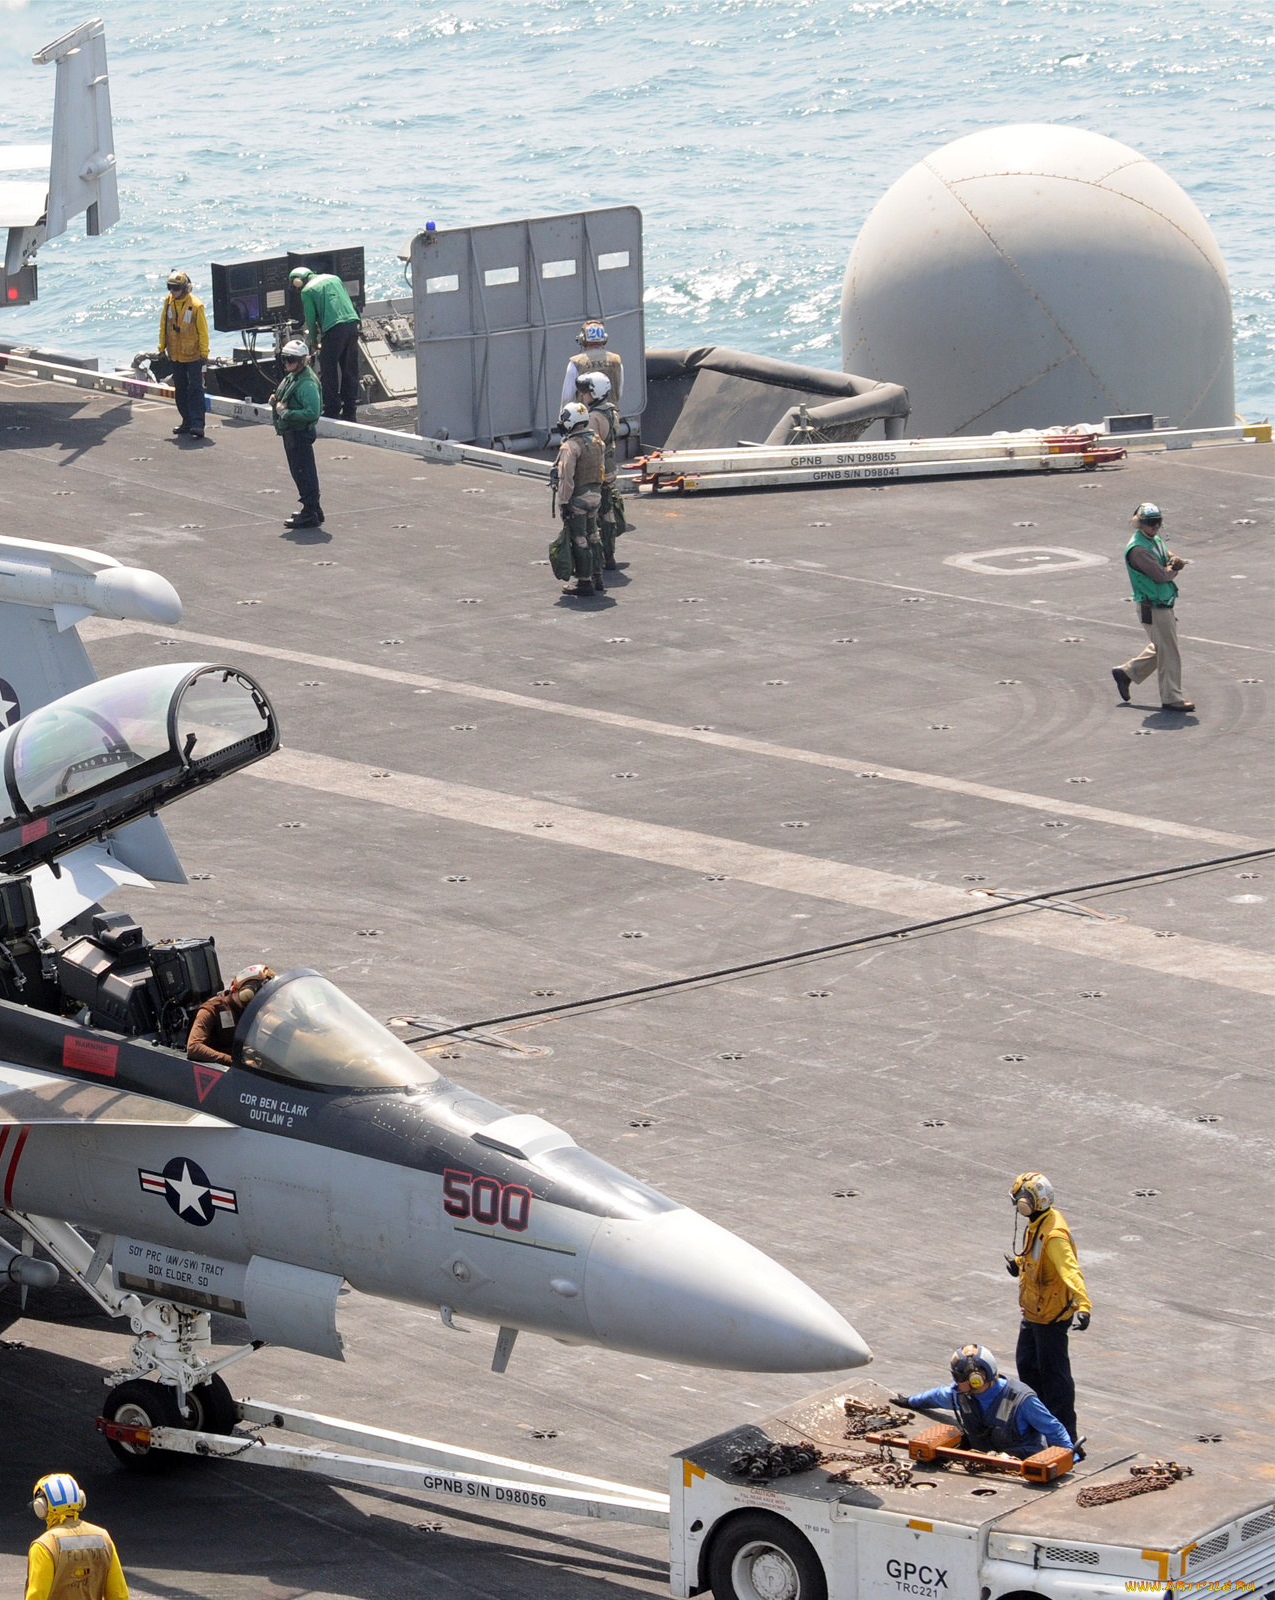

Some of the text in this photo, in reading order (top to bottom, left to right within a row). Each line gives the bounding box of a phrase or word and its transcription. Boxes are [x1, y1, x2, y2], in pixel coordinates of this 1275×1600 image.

[791, 452, 896, 466] GPNB S/N D98055
[813, 468, 900, 480] GPNB S/N D98041
[75, 1040, 108, 1053] WARNING
[239, 1092, 309, 1117] CDR BEN CLARK
[250, 1109, 294, 1127] OUTLAW 2
[443, 1168, 533, 1232] 500
[129, 1245, 225, 1276] SOY PRC (AW/SW) TRACY
[148, 1264, 209, 1287] BOX ELDER, SD
[424, 1476, 547, 1507] GPNB S/N D98056
[751, 1489, 776, 1498] CAUTION
[886, 1559, 948, 1589] GPCX
[895, 1581, 938, 1598] TRC221
